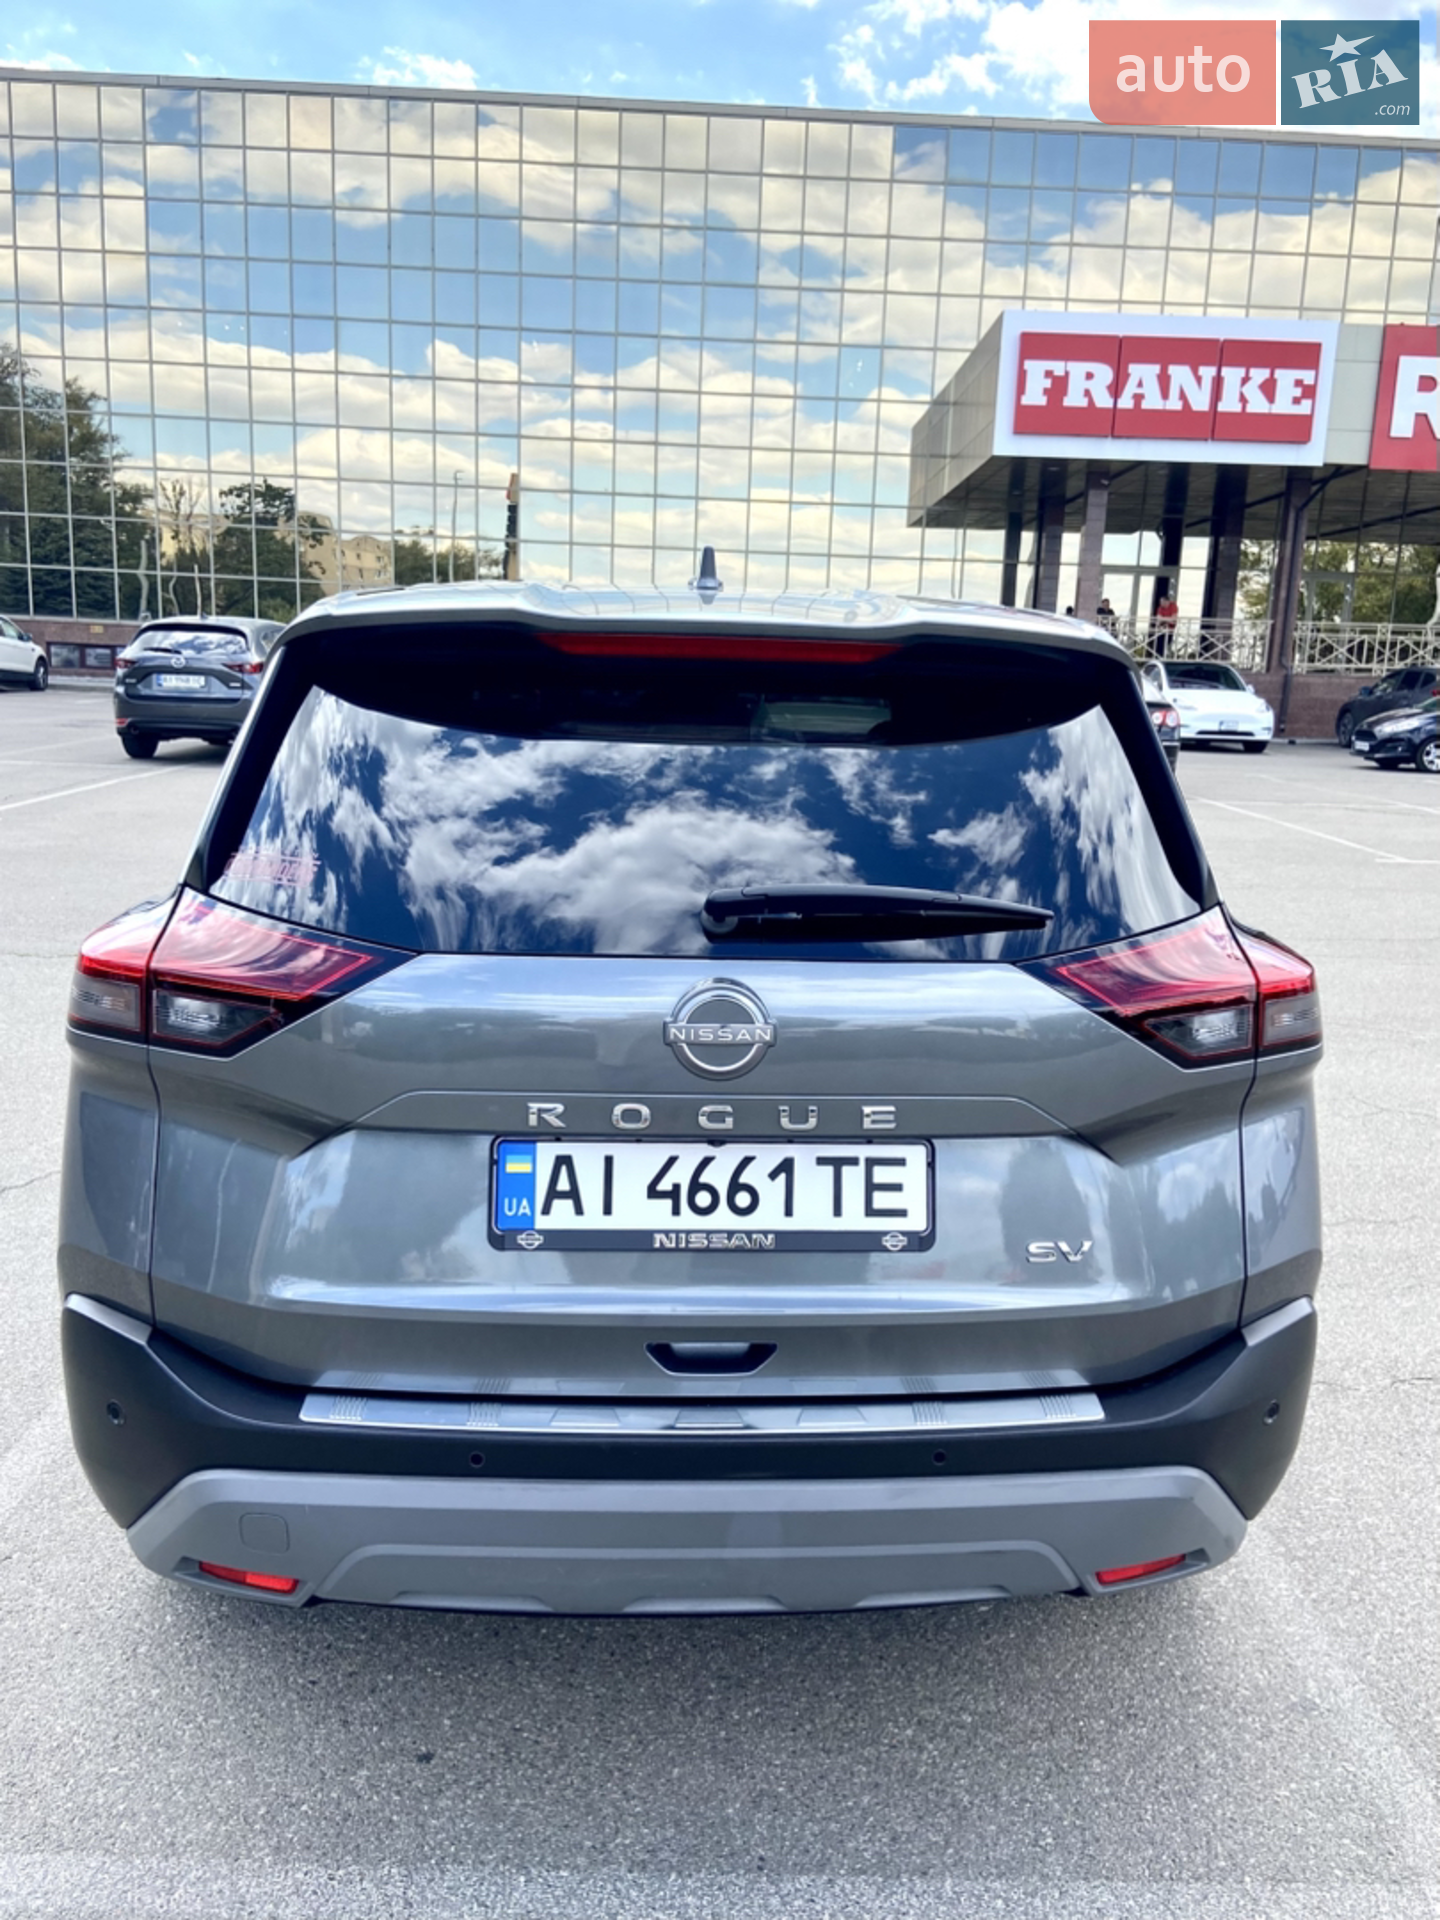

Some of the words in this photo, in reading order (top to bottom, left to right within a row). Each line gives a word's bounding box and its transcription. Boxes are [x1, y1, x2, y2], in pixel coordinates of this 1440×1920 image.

[1020, 359, 1316, 415] FRANKE
[669, 1026, 772, 1042] NISSAN
[527, 1102, 897, 1131] ROGUE
[540, 1154, 614, 1217] AI
[646, 1155, 795, 1218] 4661
[816, 1156, 908, 1218] TE
[504, 1197, 531, 1217] UA
[653, 1233, 775, 1249] NISSAN
[1026, 1240, 1093, 1263] SV
